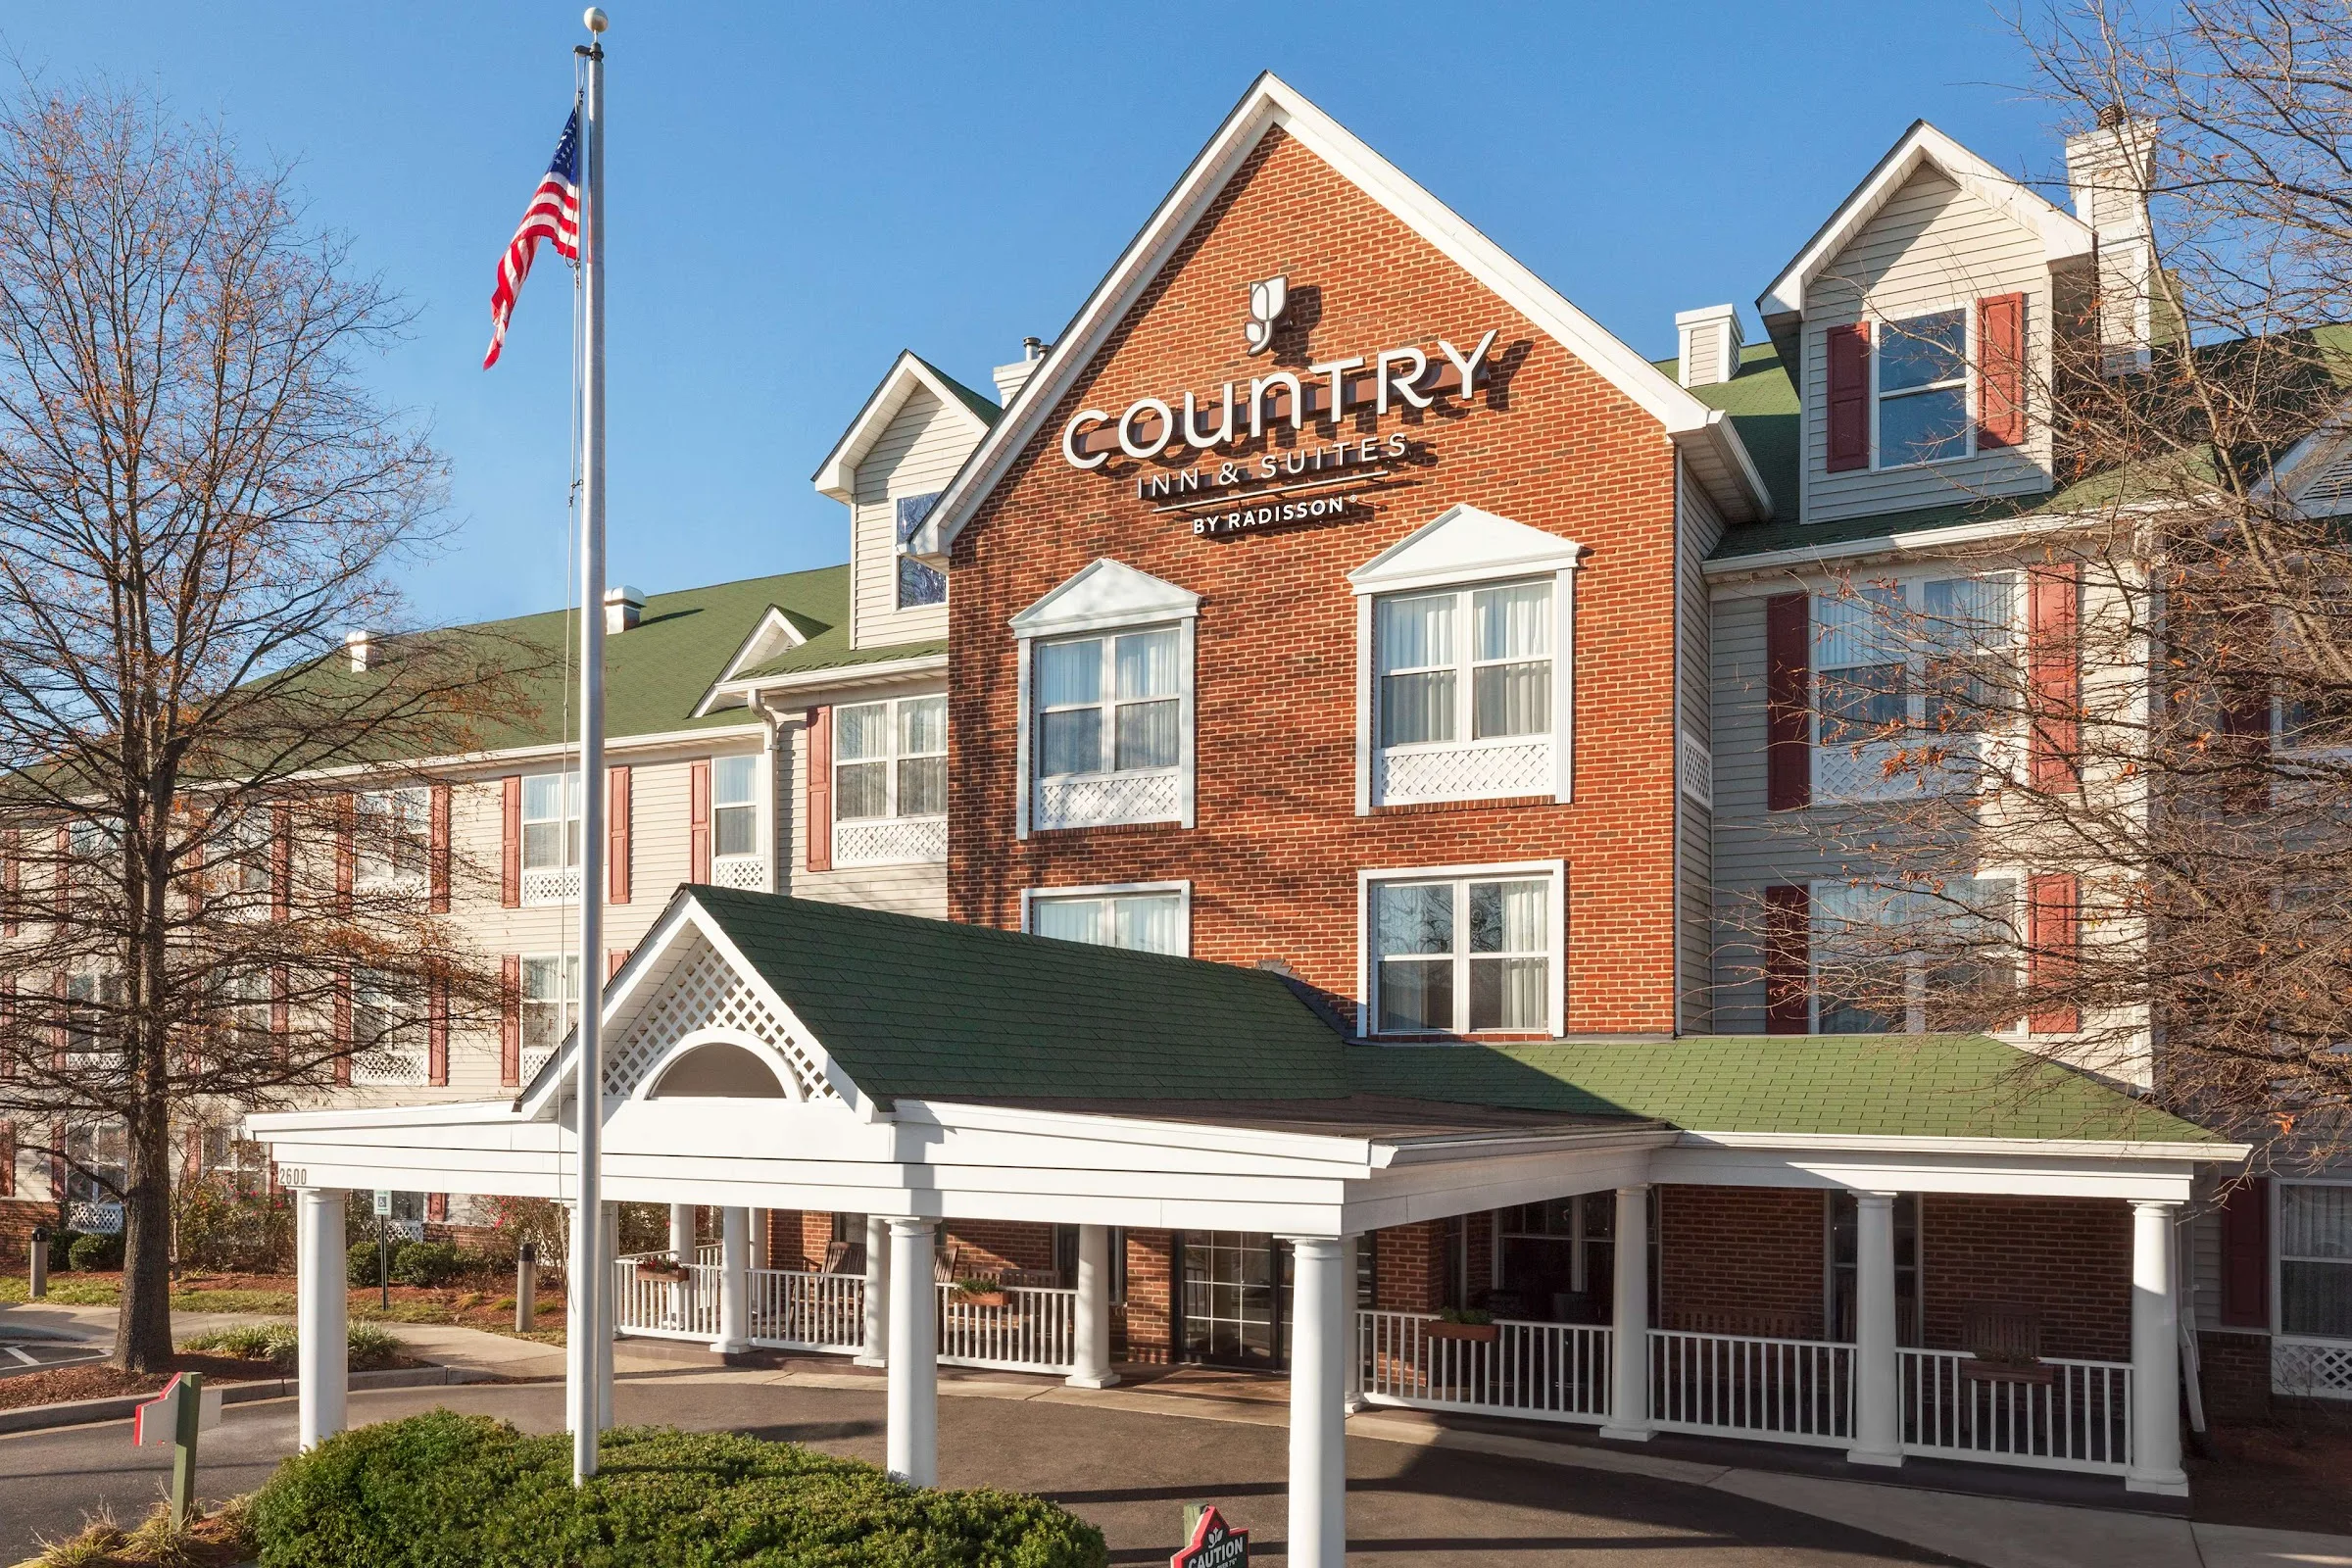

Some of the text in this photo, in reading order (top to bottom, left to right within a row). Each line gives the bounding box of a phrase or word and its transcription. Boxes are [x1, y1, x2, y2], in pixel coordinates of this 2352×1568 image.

[1138, 432, 1405, 499] INN & SUITES
[1194, 496, 1344, 535] BY RADISSON
[279, 1167, 307, 1186] 2600
[1188, 1537, 1243, 1568] CAUTION
